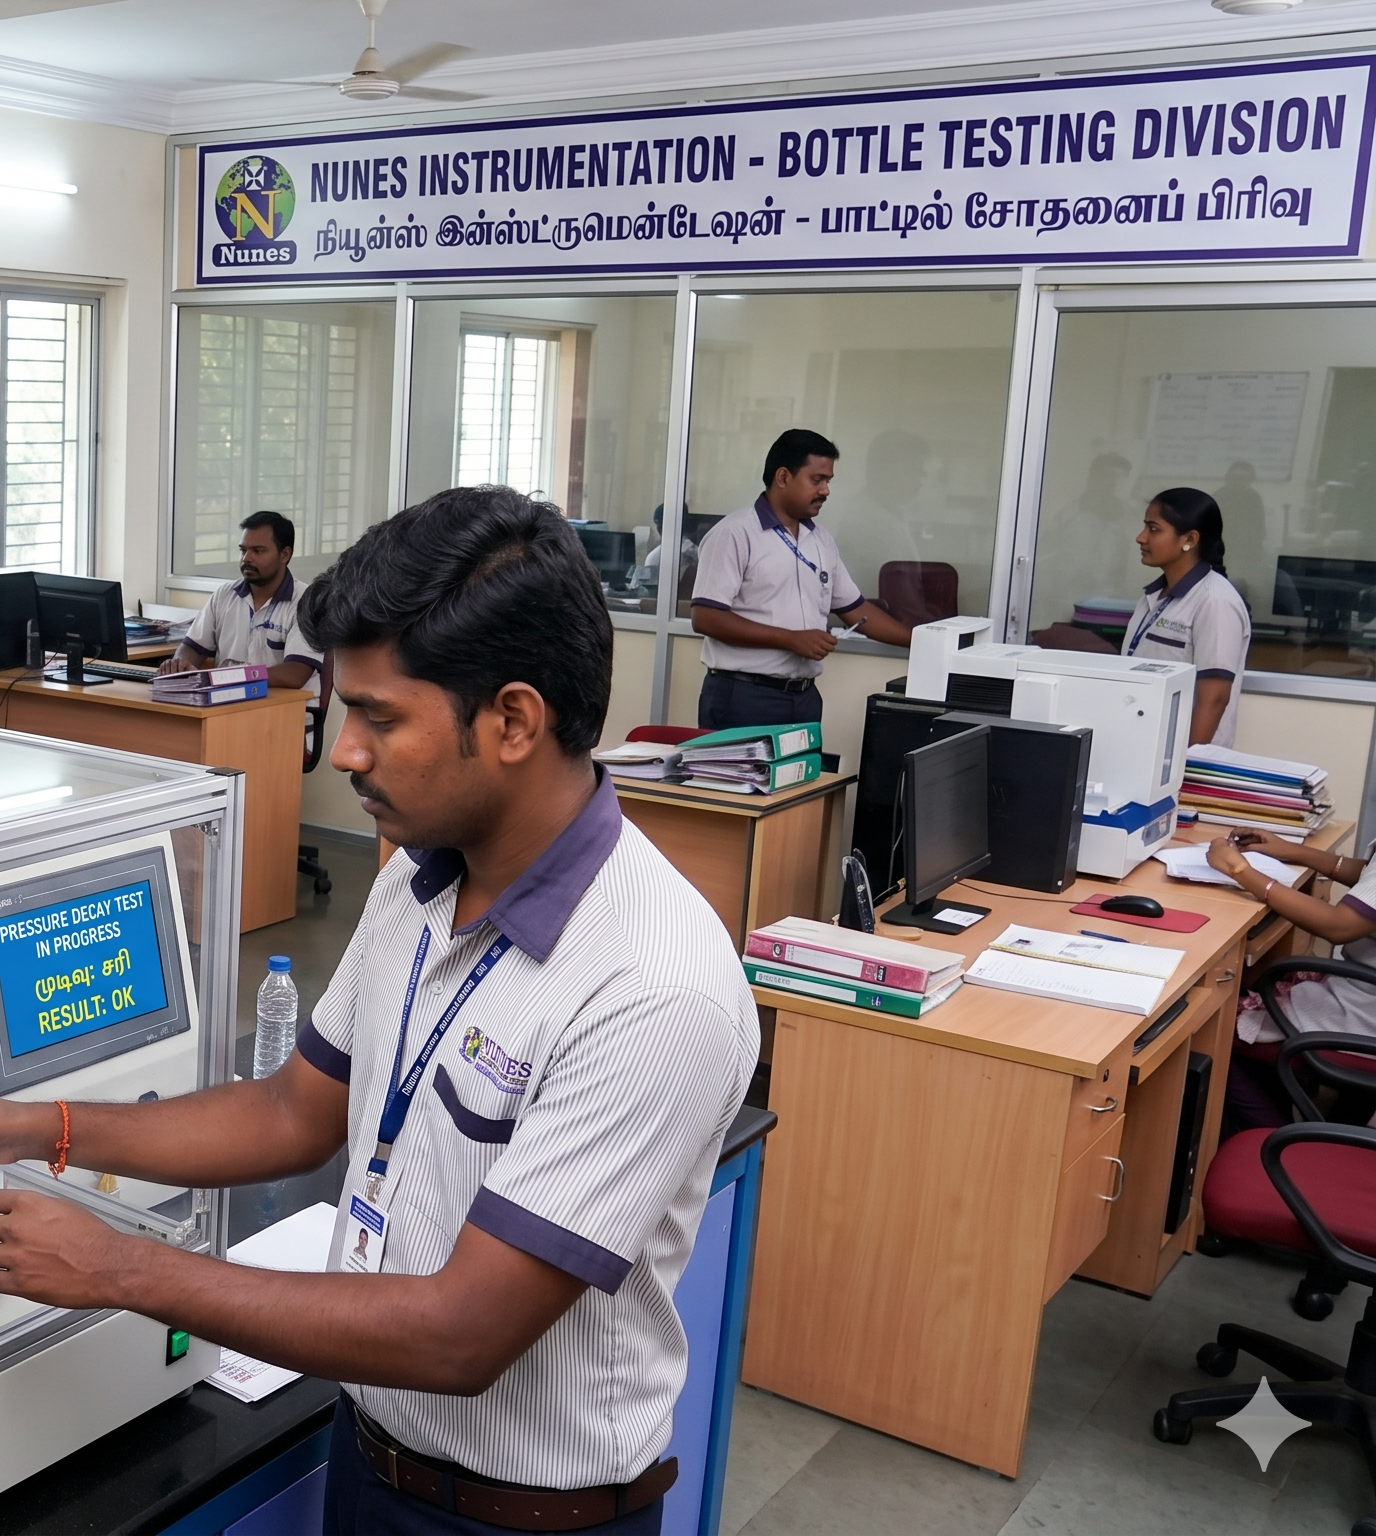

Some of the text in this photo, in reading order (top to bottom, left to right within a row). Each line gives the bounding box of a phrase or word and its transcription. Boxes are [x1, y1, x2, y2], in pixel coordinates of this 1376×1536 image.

[310, 94, 1347, 203] NUNES INSTRUMENTATION - BOTTLE TESTING DIVISION
[313, 213, 428, 262] நியூன்ஸ்
[435, 195, 786, 251] இன்ஸ்ட்ருமென்டேஷன்
[820, 189, 953, 239] பாட்டில்
[964, 177, 1185, 238] சோதனைப்
[1196, 174, 1313, 226] பிரிவு
[220, 246, 291, 264] Nunes
[0, 890, 144, 944] PRESSURE DECAY TEST
[35, 921, 121, 959] IN PROGRESS
[35, 948, 131, 1003] முடிவு: சரி
[38, 984, 136, 1035] RESULT: OK
